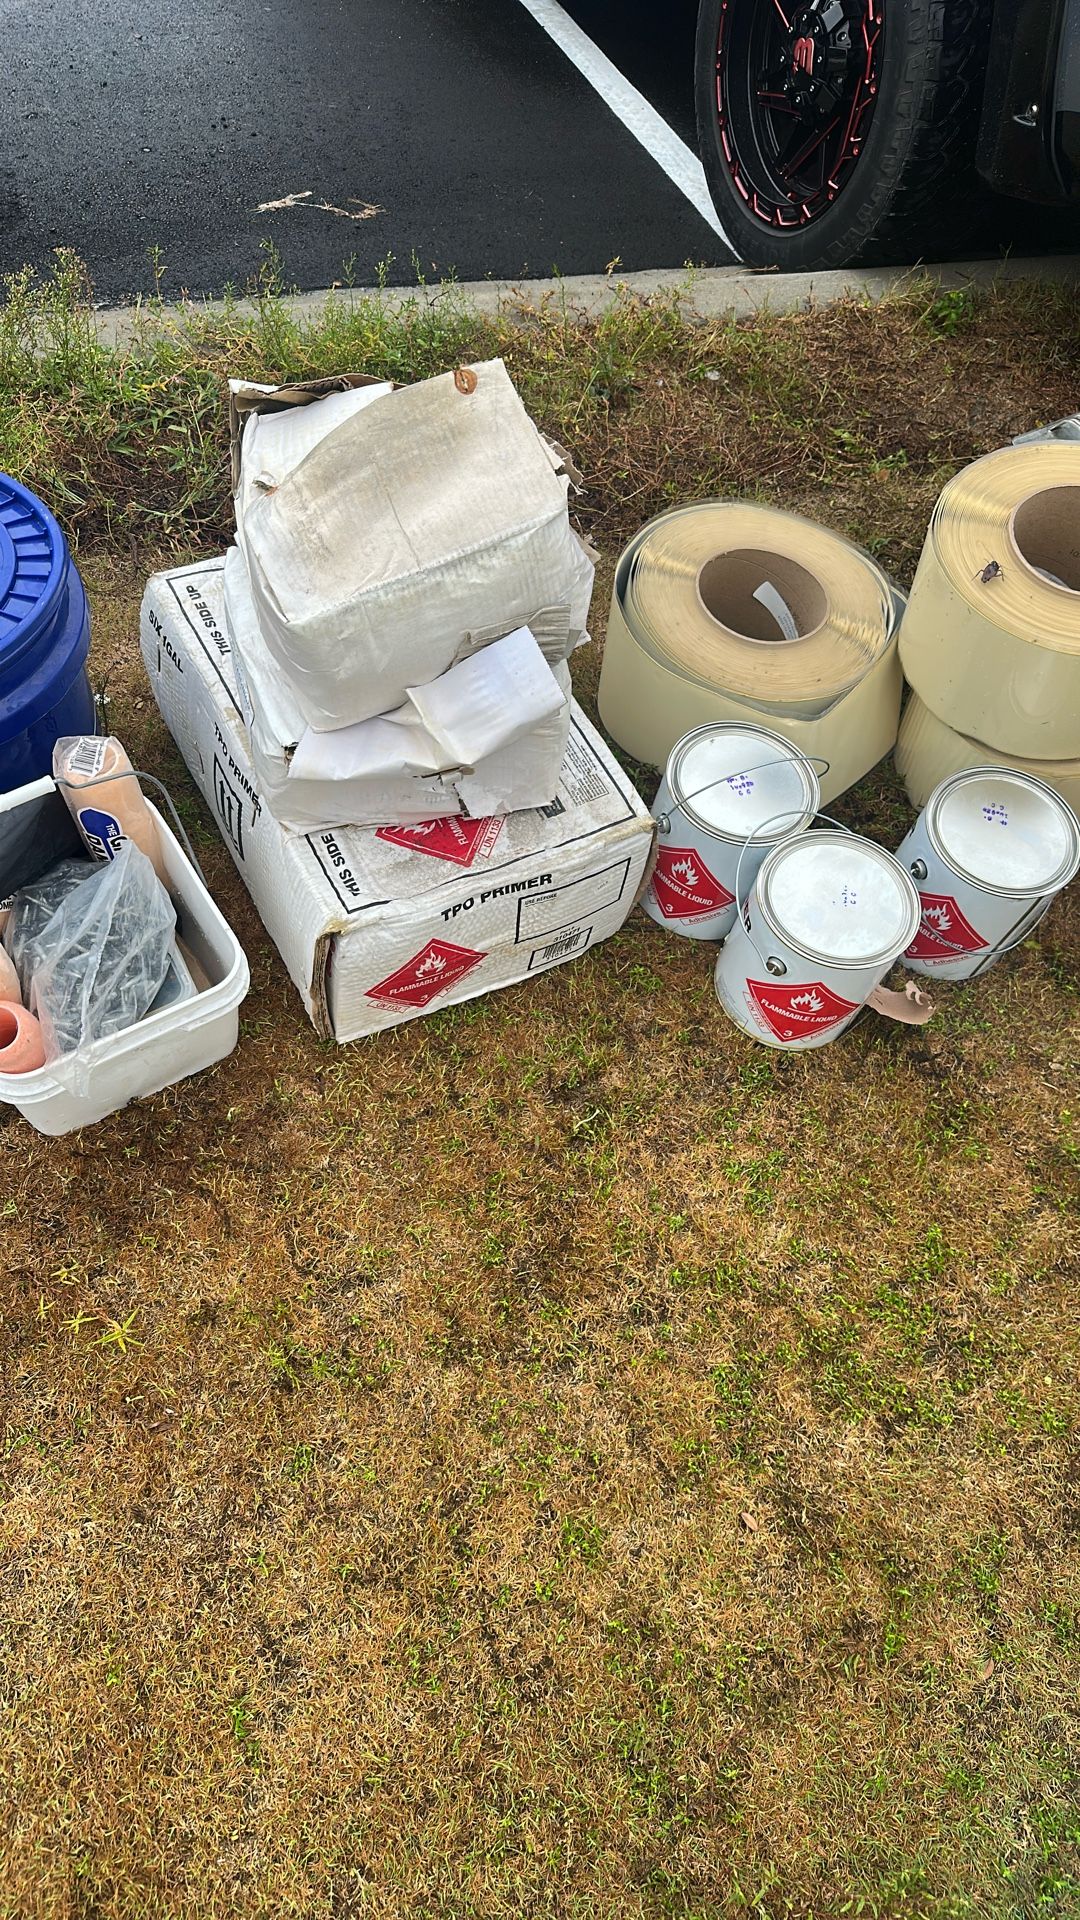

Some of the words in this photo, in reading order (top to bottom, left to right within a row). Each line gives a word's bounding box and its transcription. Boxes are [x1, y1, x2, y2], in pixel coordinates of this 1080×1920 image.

[185, 585, 202, 600] UP
[194, 601, 217, 628] SIDE
[148, 609, 163, 637] SIX
[162, 635, 184, 674] 1GAL
[210, 630, 231, 656] THIS
[214, 721, 228, 757] TPO
[228, 755, 262, 818] PRIMER
[105, 823, 118, 837] THE
[483, 837, 494, 848] UN
[490, 819, 501, 836] 1133
[320, 832, 346, 868] SIDE
[338, 868, 361, 897] THIS
[440, 896, 475, 922] TPO
[480, 873, 553, 904] PRIMER
[665, 903, 674, 912] 3
[687, 892, 714, 906] LIQUID
[909, 944, 918, 953] 3
[389, 976, 440, 996] FLAMMABLE
[440, 965, 465, 980] LIQUID
[760, 998, 811, 1023] FLAMMABLE
[811, 1015, 838, 1023] LIQUID
